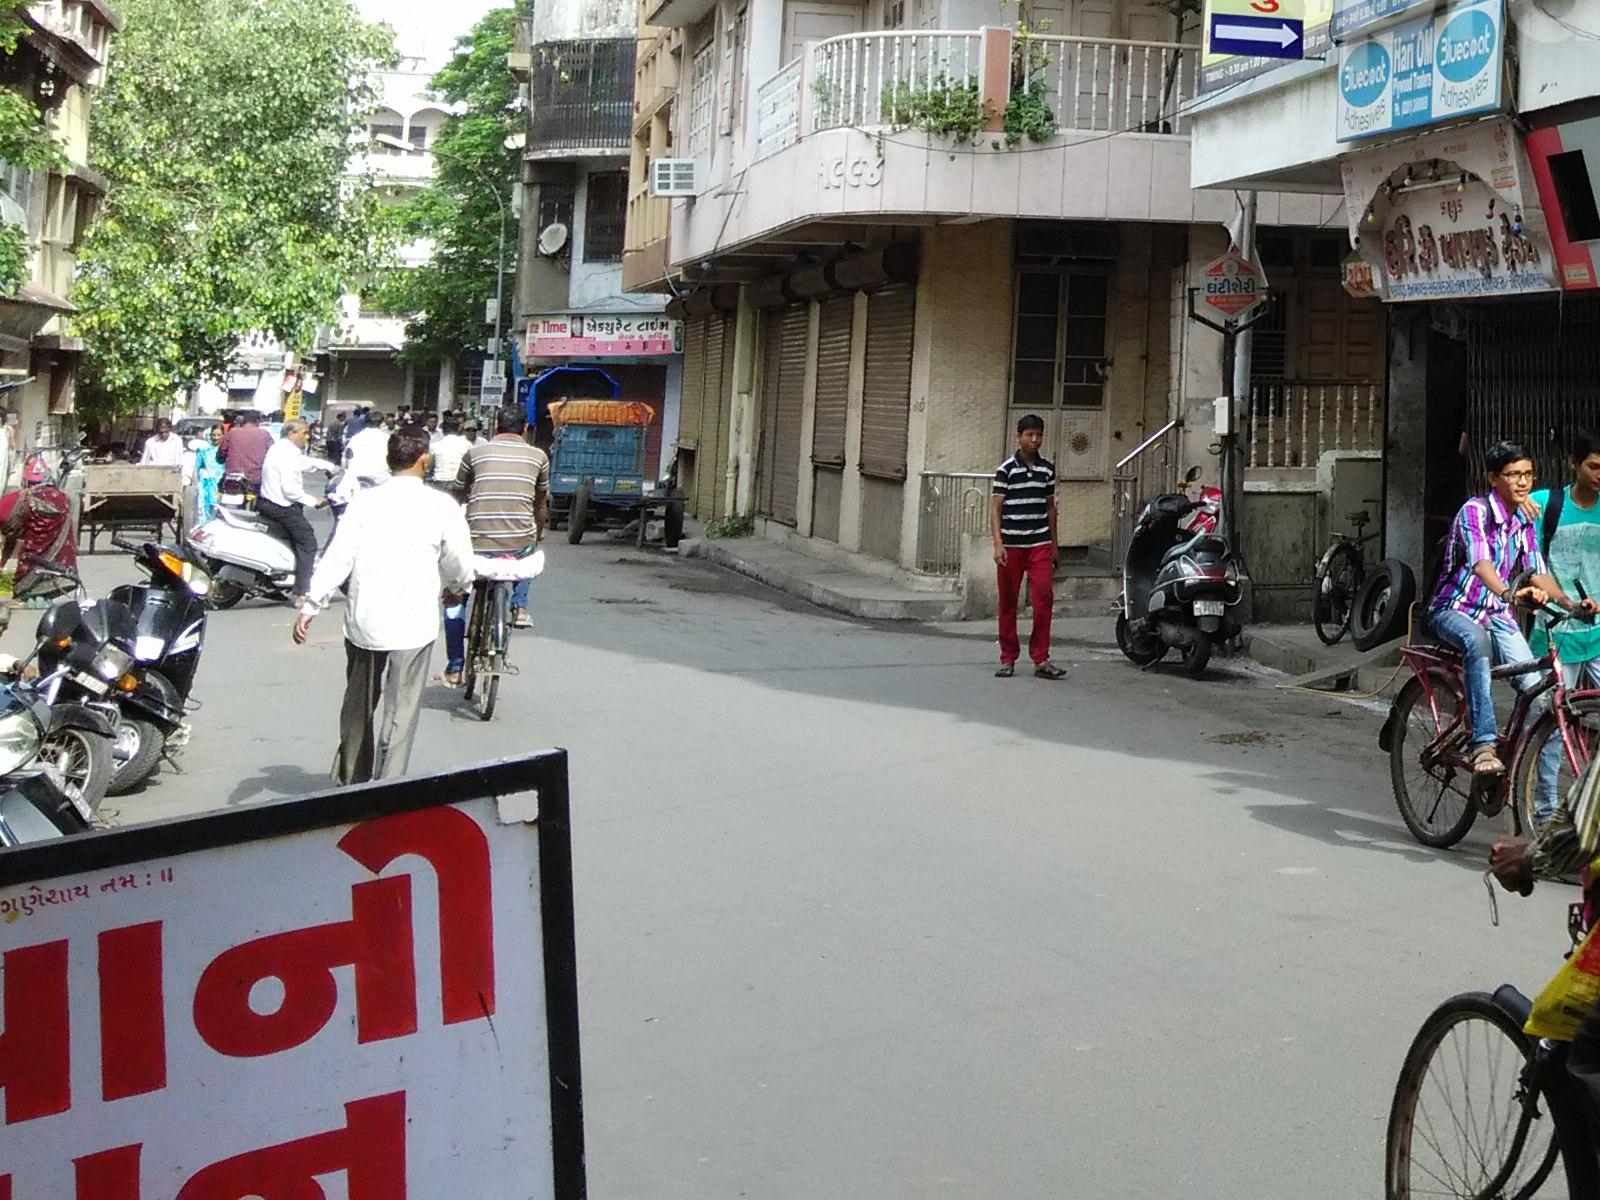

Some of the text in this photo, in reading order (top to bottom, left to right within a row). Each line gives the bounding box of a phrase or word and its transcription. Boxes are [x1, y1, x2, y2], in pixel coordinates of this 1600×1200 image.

[1394, 33, 1414, 73] Hari
[1440, 72, 1489, 107] Adhesives
[1344, 99, 1385, 130] Adhesives
[542, 320, 567, 333] Time
